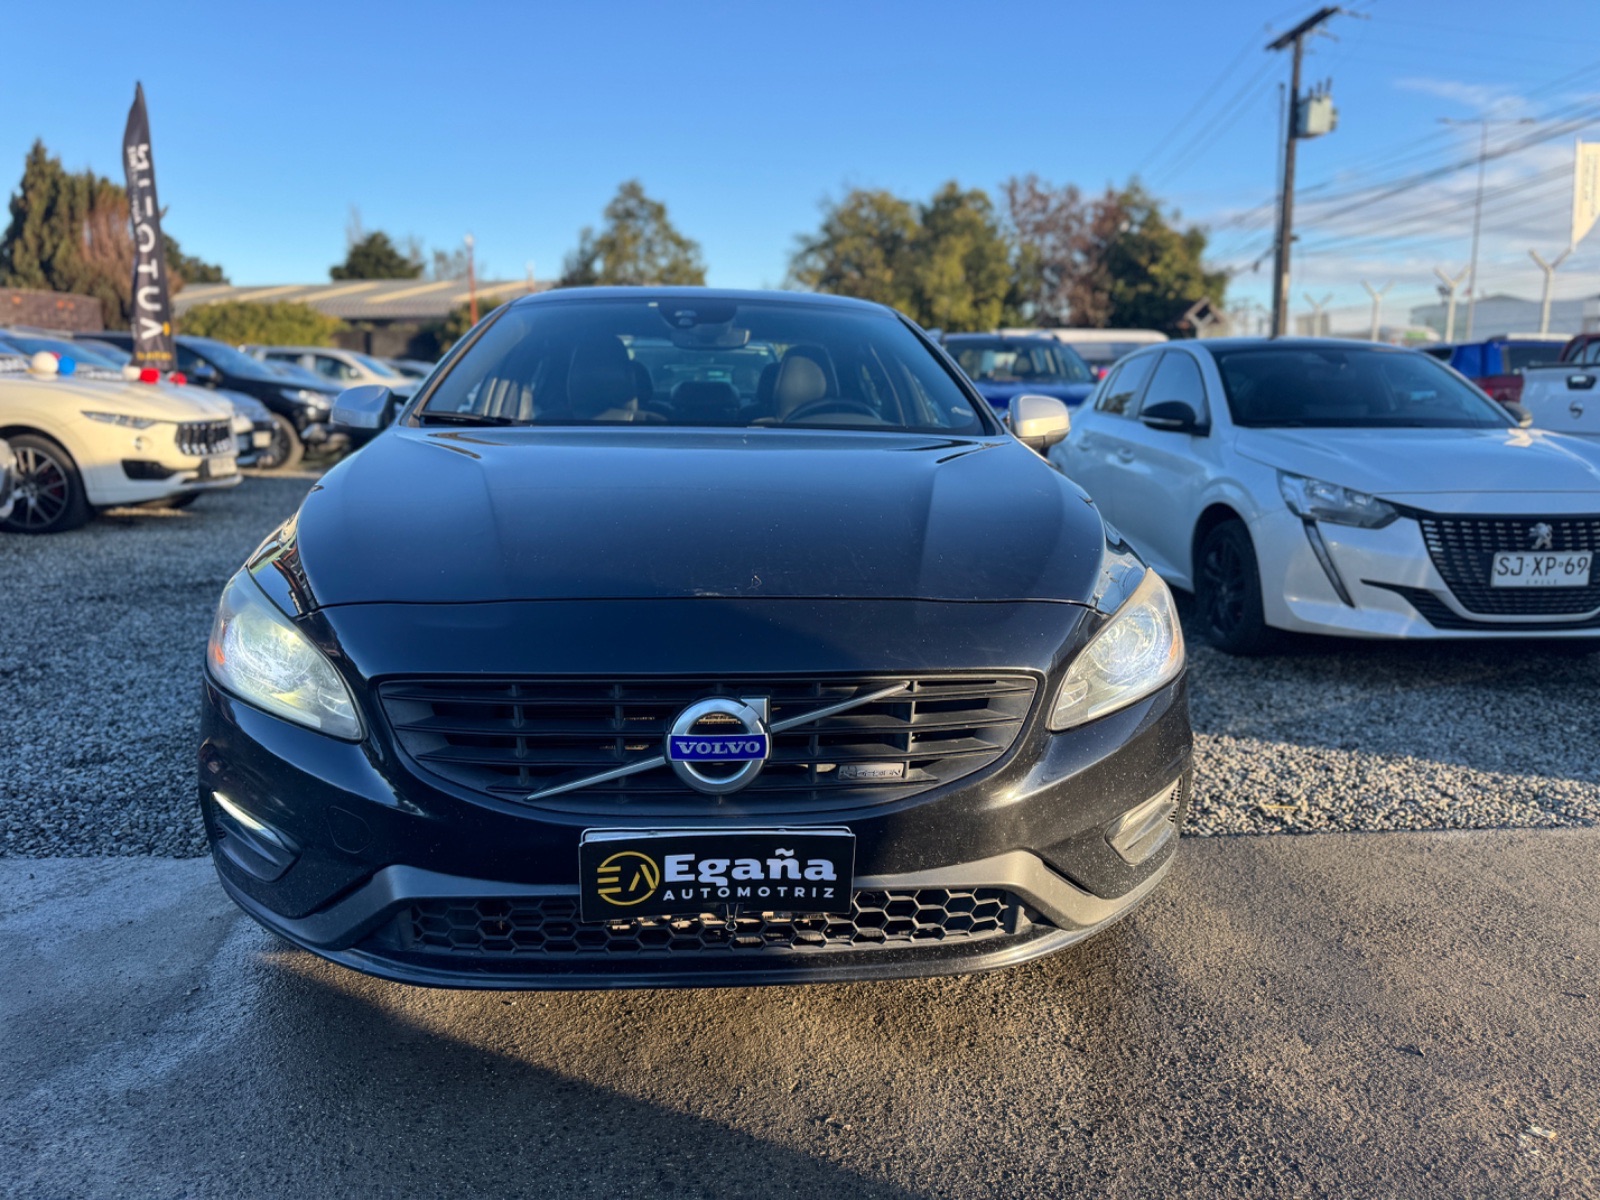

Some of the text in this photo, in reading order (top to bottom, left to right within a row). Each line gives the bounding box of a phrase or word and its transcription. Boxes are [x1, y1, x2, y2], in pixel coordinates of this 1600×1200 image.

[675, 741, 761, 754] VOLVO
[664, 848, 837, 886] Egaña
[663, 886, 835, 901] AUTOMOTRIZ
